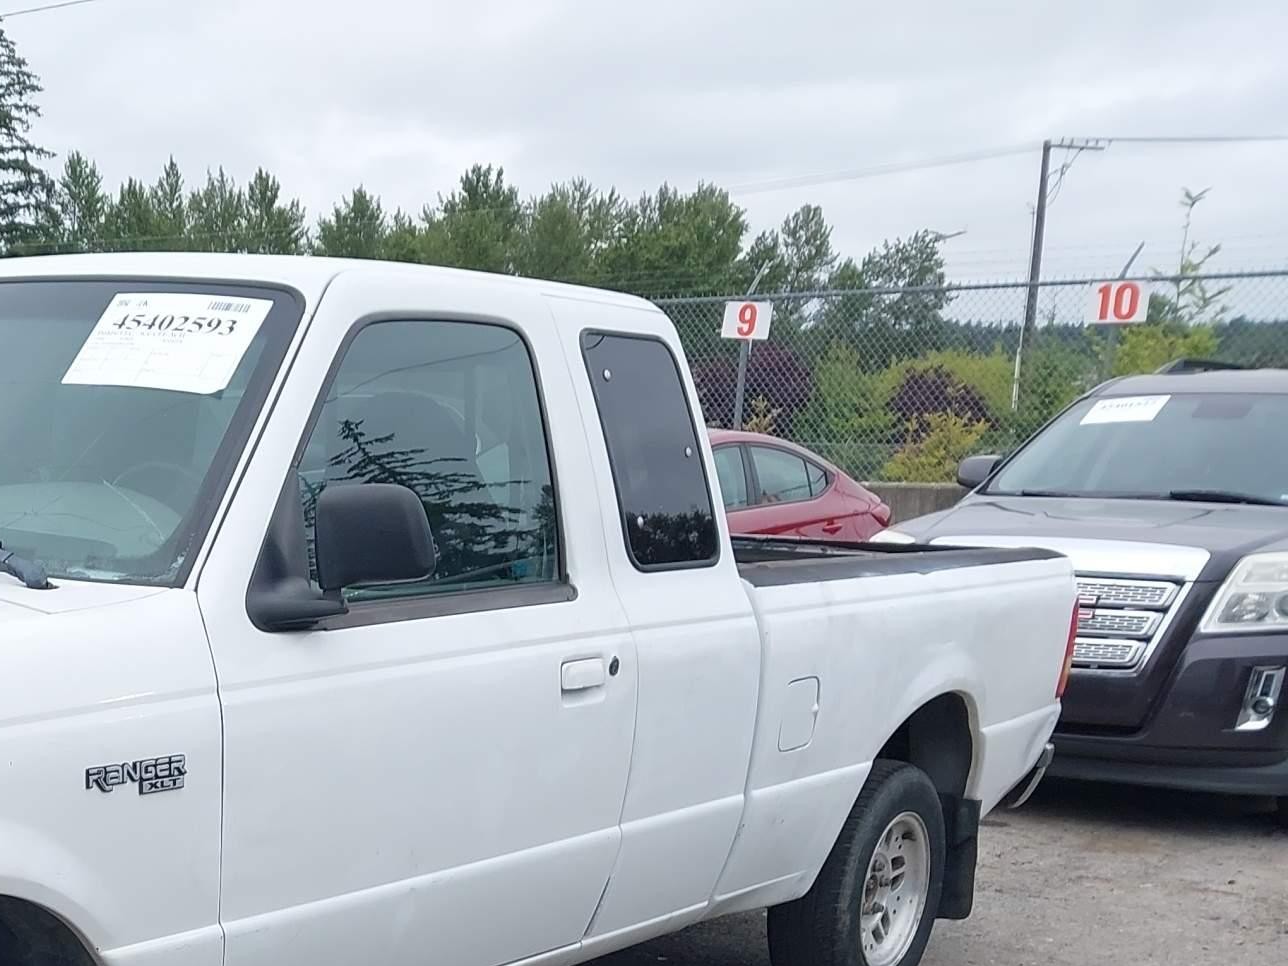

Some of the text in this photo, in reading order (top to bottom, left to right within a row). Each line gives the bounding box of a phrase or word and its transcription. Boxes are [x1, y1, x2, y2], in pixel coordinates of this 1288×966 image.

[1098, 282, 1140, 320] 10
[113, 313, 238, 336] 45402593
[737, 304, 757, 337] 9
[145, 777, 184, 792] XLT
